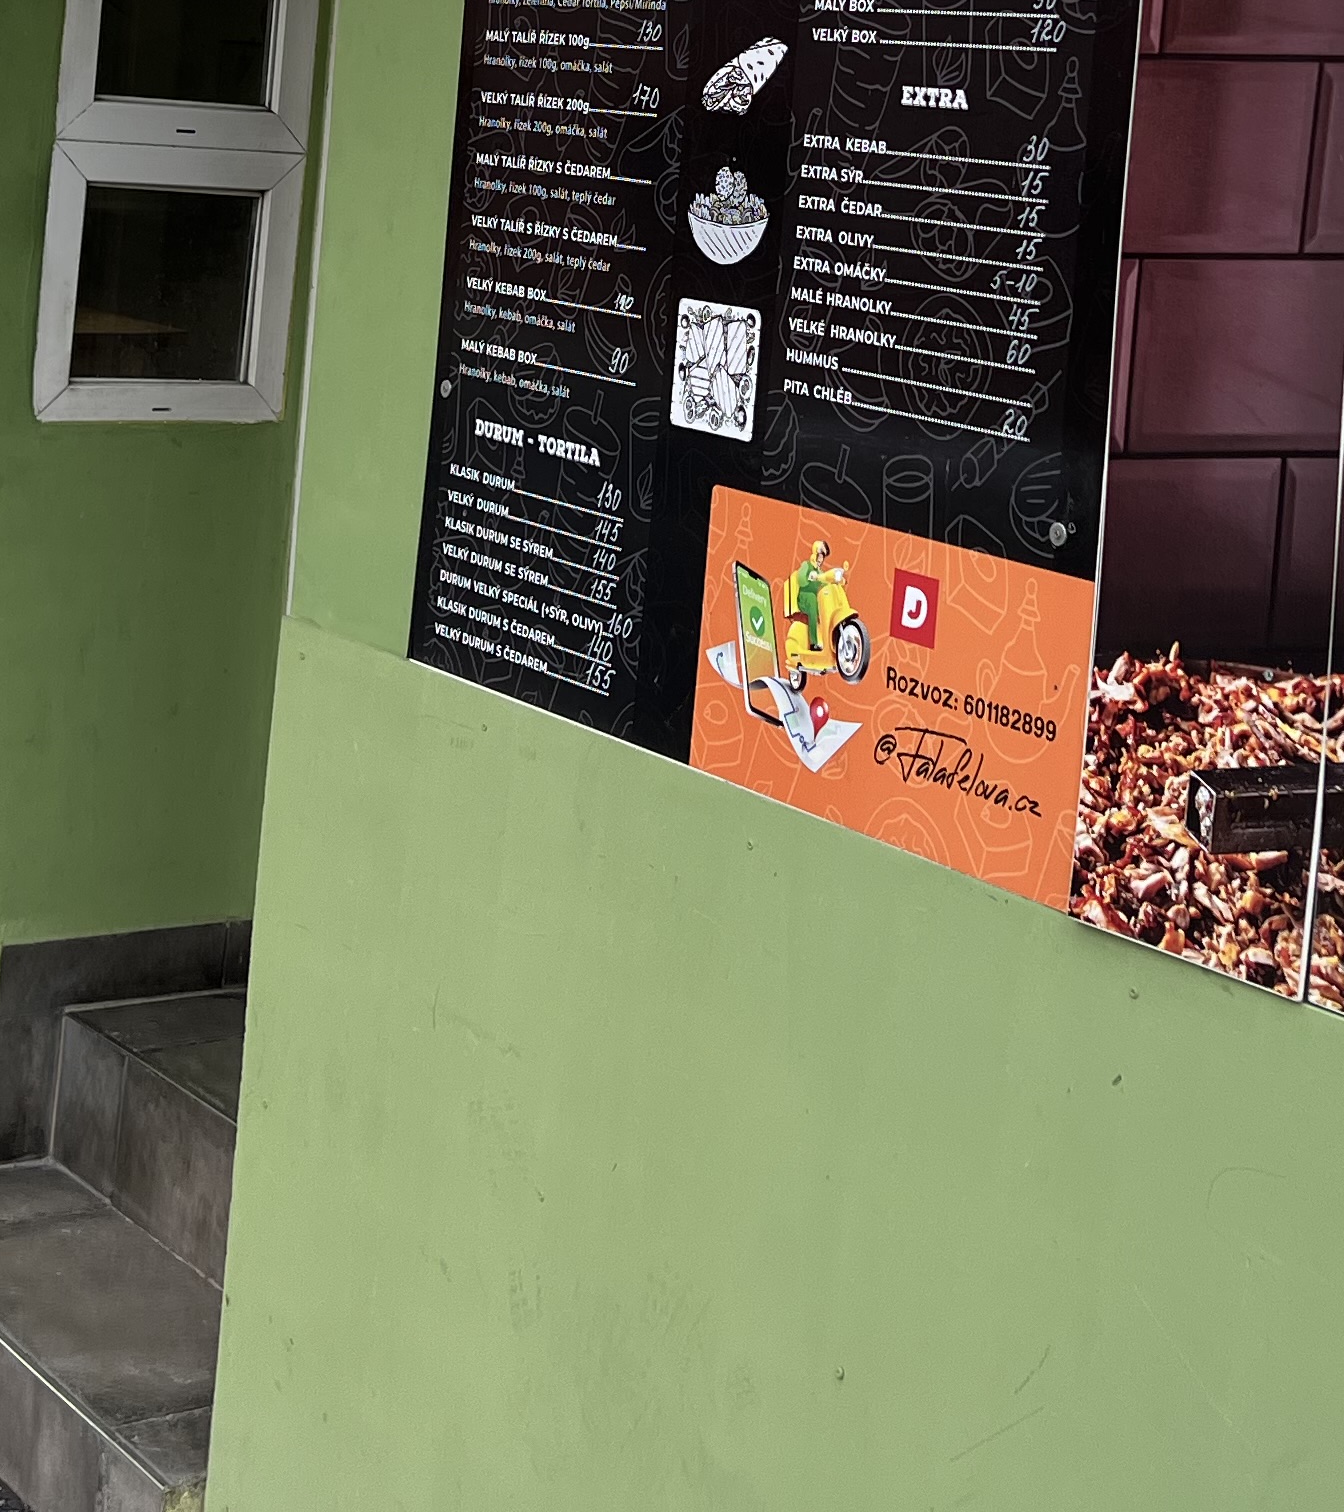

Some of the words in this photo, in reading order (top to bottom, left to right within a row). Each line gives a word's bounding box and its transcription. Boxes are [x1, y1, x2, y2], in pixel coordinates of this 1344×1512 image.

[485, 29, 511, 43] MALÝ
[511, 29, 537, 44] TALÍŘ
[538, 29, 566, 46] ŘÍZEK
[568, 33, 591, 50] 100g
[636, 19, 662, 42] 130
[812, 25, 849, 43] VELKÝ
[851, 29, 877, 44] BOX
[1030, 19, 1067, 43] 120
[480, 90, 509, 105] VELKÝ
[510, 92, 536, 108] TALÍŘ
[537, 93, 565, 110] ŘÍZEK
[565, 98, 591, 115] 200g
[632, 83, 660, 110] 170
[900, 85, 969, 110] EXTRA
[803, 133, 841, 151] EXTRA
[845, 137, 888, 155] KEBAB
[1022, 135, 1050, 162] 30
[800, 164, 839, 181] EXTRA
[840, 166, 864, 184] SÝR
[1021, 171, 1050, 196] 15
[798, 194, 836, 212] EXTRA
[840, 196, 883, 218] ČEDAR
[1017, 205, 1046, 228] 15
[795, 225, 833, 243] EXTRA
[838, 230, 875, 249] OLIVY
[1015, 238, 1043, 260] 15
[793, 255, 831, 274] EXTRA
[834, 261, 887, 283] OMÁČKY
[790, 286, 823, 305] MALÉ
[826, 292, 893, 316] HRANOLKY
[1008, 303, 1040, 331] 45
[461, 338, 486, 354] MALÝ
[485, 343, 516, 361] KEBAB
[517, 350, 538, 366] BOX
[608, 347, 629, 374] 90
[786, 347, 839, 370] HUMMUS
[788, 317, 826, 336] VELKÉ
[830, 324, 897, 349] HRANOLKY
[1006, 339, 1031, 365] 60
[783, 378, 810, 397] PITA
[813, 384, 853, 405] CHLÉB
[1001, 408, 1028, 437] 20
[474, 418, 524, 447] DURUM
[537, 434, 601, 467] TORTILA
[449, 463, 480, 482] KLASIK
[482, 472, 516, 492] DURUM
[597, 481, 622, 511] 130
[447, 489, 475, 507] VELKÝ
[476, 497, 510, 518] DURUM
[594, 519, 624, 543] 145
[886, 666, 959, 711] Rozvoz:
[963, 694, 1057, 742] 601182899
[873, 726, 1042, 818] @Falafelova.cz
